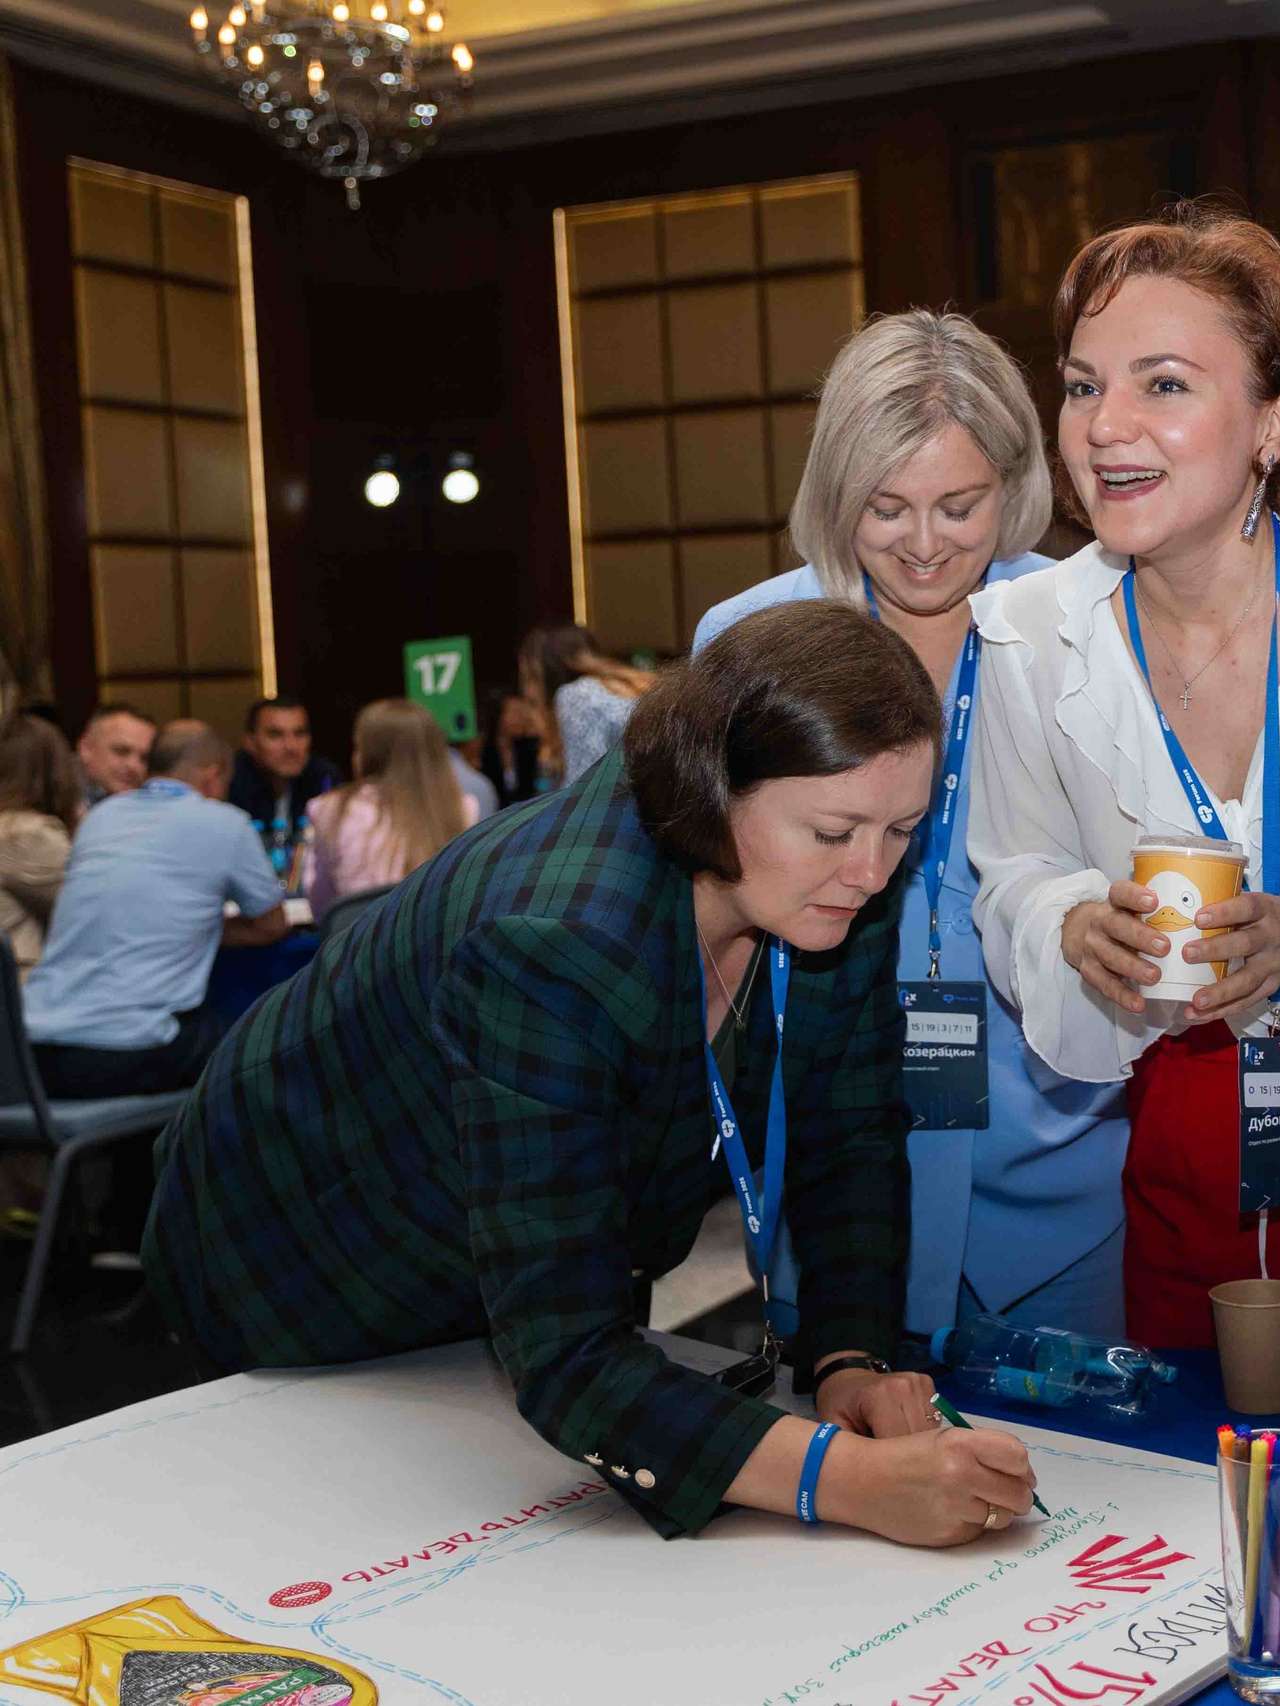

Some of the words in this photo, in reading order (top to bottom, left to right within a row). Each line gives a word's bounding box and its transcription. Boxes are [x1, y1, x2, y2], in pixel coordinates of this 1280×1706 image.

[413, 651, 461, 695] 17
[480, 1480, 611, 1533] РАТИТЬ
[342, 1531, 490, 1583] ДЕЛАТЬ
[985, 1559, 1018, 1581] для
[1024, 1601, 1107, 1633] ЧТО
[891, 1641, 1033, 1706] ДЕЛАТ
